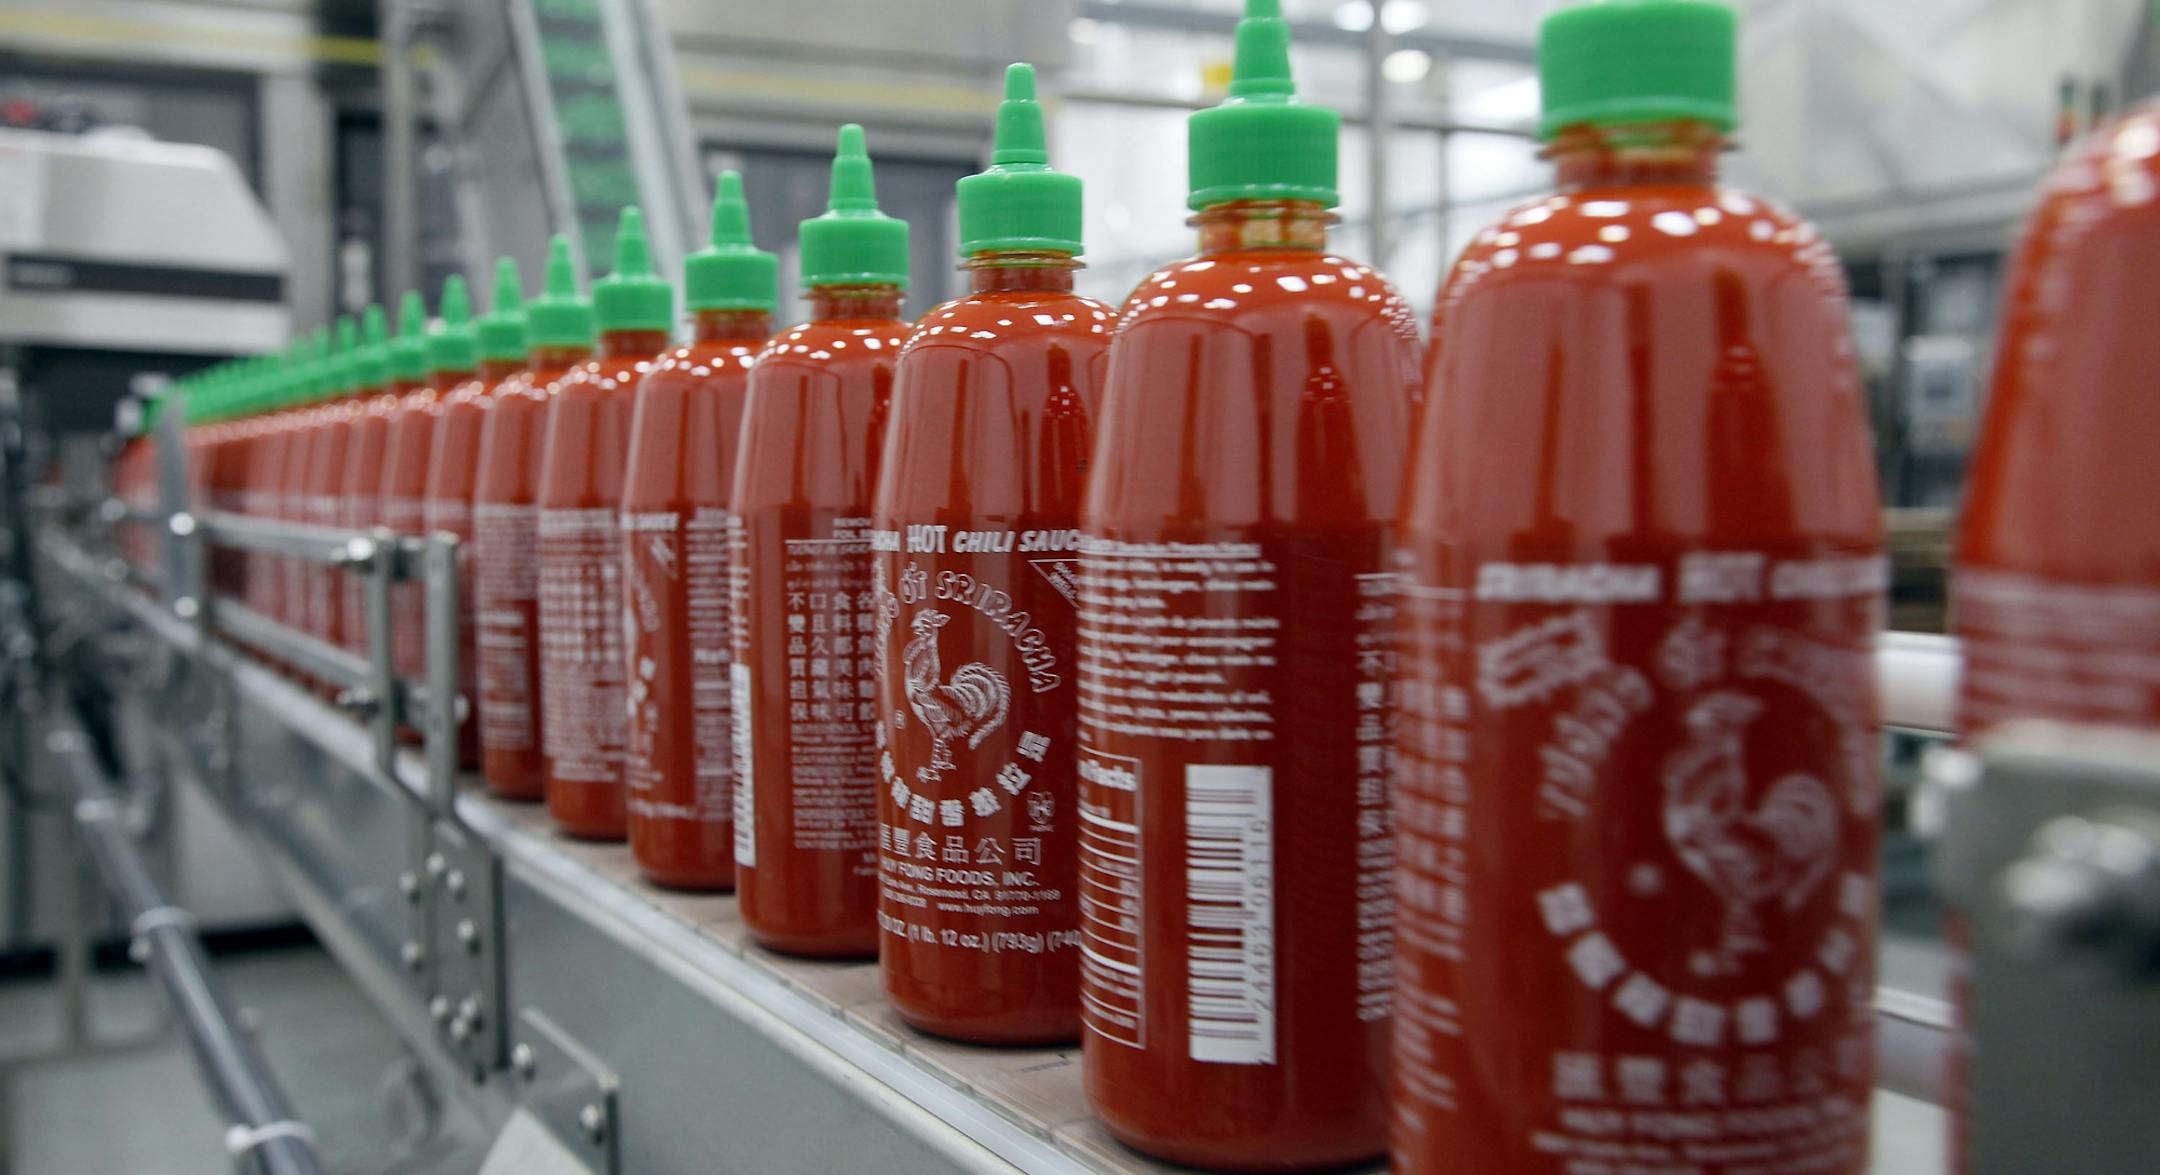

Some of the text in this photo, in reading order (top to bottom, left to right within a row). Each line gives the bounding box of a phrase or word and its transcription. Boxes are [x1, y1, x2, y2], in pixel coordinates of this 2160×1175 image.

[907, 525, 948, 553] HOT
[953, 531, 1016, 553] CHILI
[1018, 529, 1080, 552] SAUC
[1002, 871, 1041, 887] INC.
